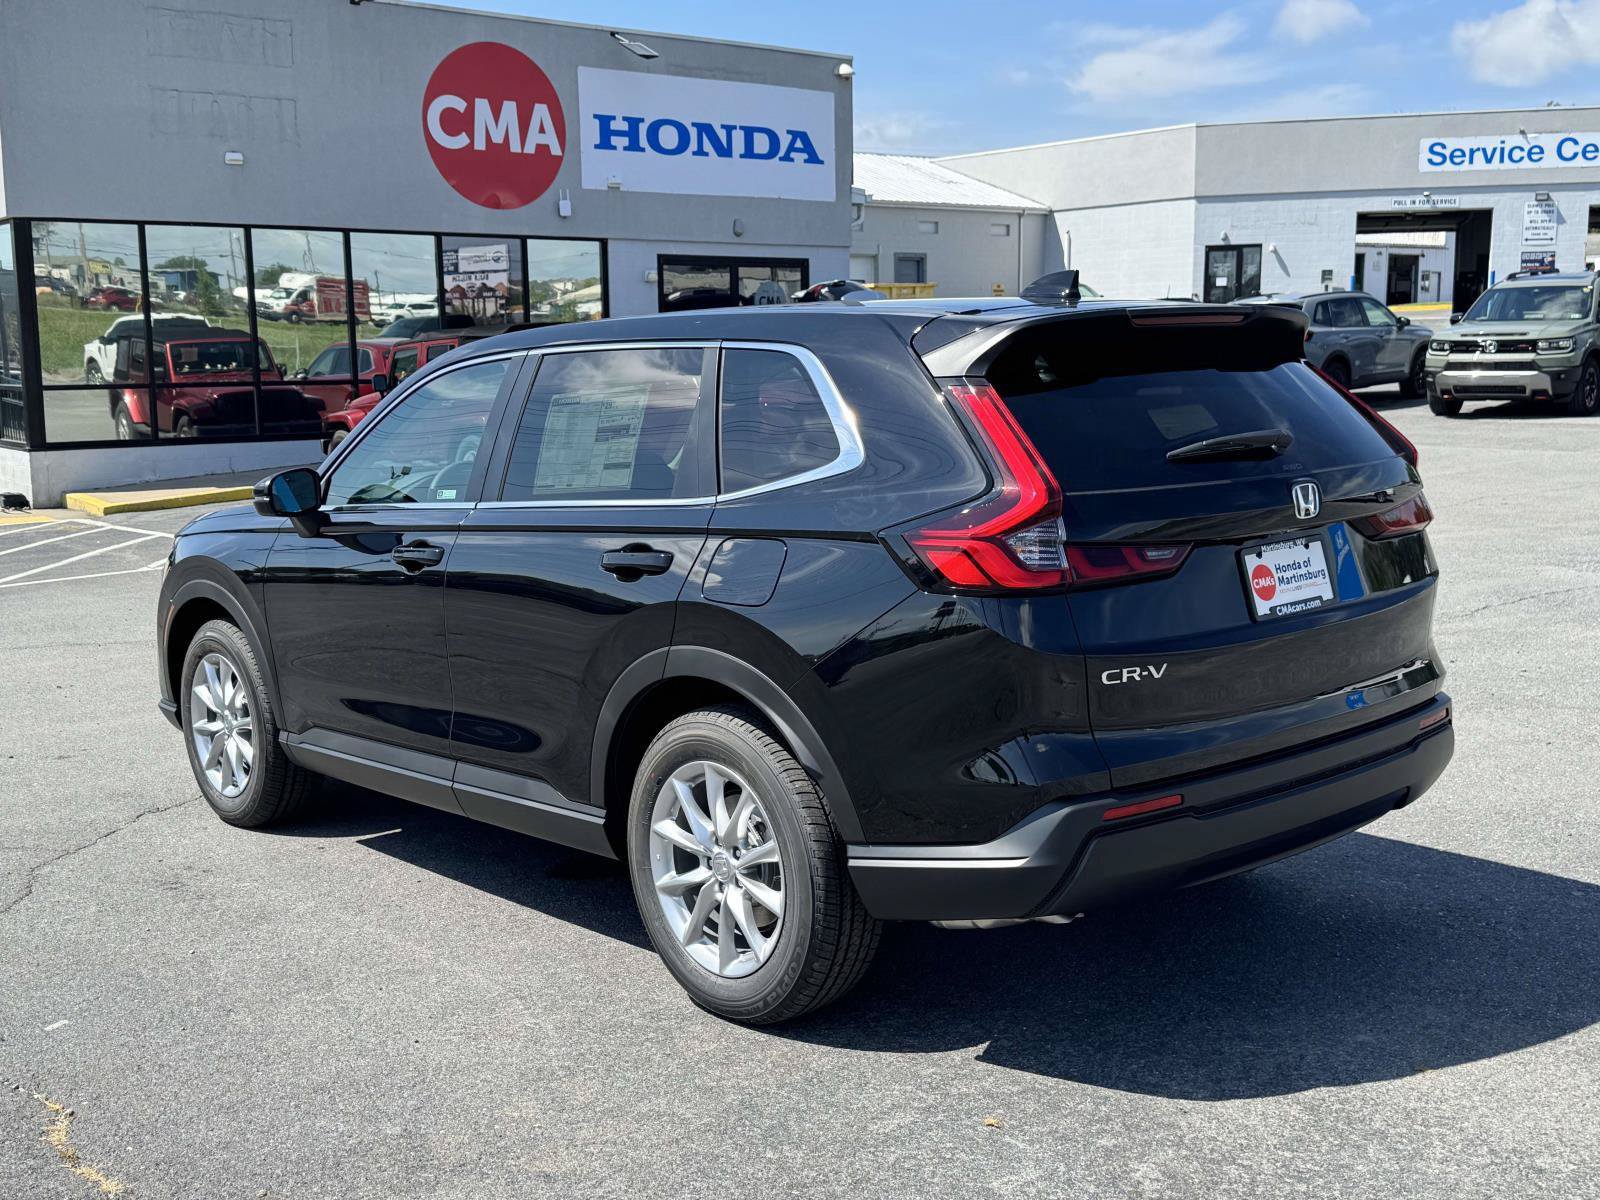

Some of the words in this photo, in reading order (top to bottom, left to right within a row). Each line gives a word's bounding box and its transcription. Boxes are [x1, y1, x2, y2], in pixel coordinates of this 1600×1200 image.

[427, 95, 563, 156] CMA
[593, 114, 825, 165] HONDA
[1428, 141, 1544, 166] Service
[1556, 137, 1600, 161] Ce
[1432, 198, 1457, 206] SERVICE
[1275, 560, 1302, 573] Honda
[1303, 557, 1311, 567] of
[1253, 577, 1275, 588] CMA's
[1278, 569, 1327, 587] Martinsburg
[1277, 600, 1321, 615] CMAcars.com
[1101, 663, 1168, 685] CR-V
